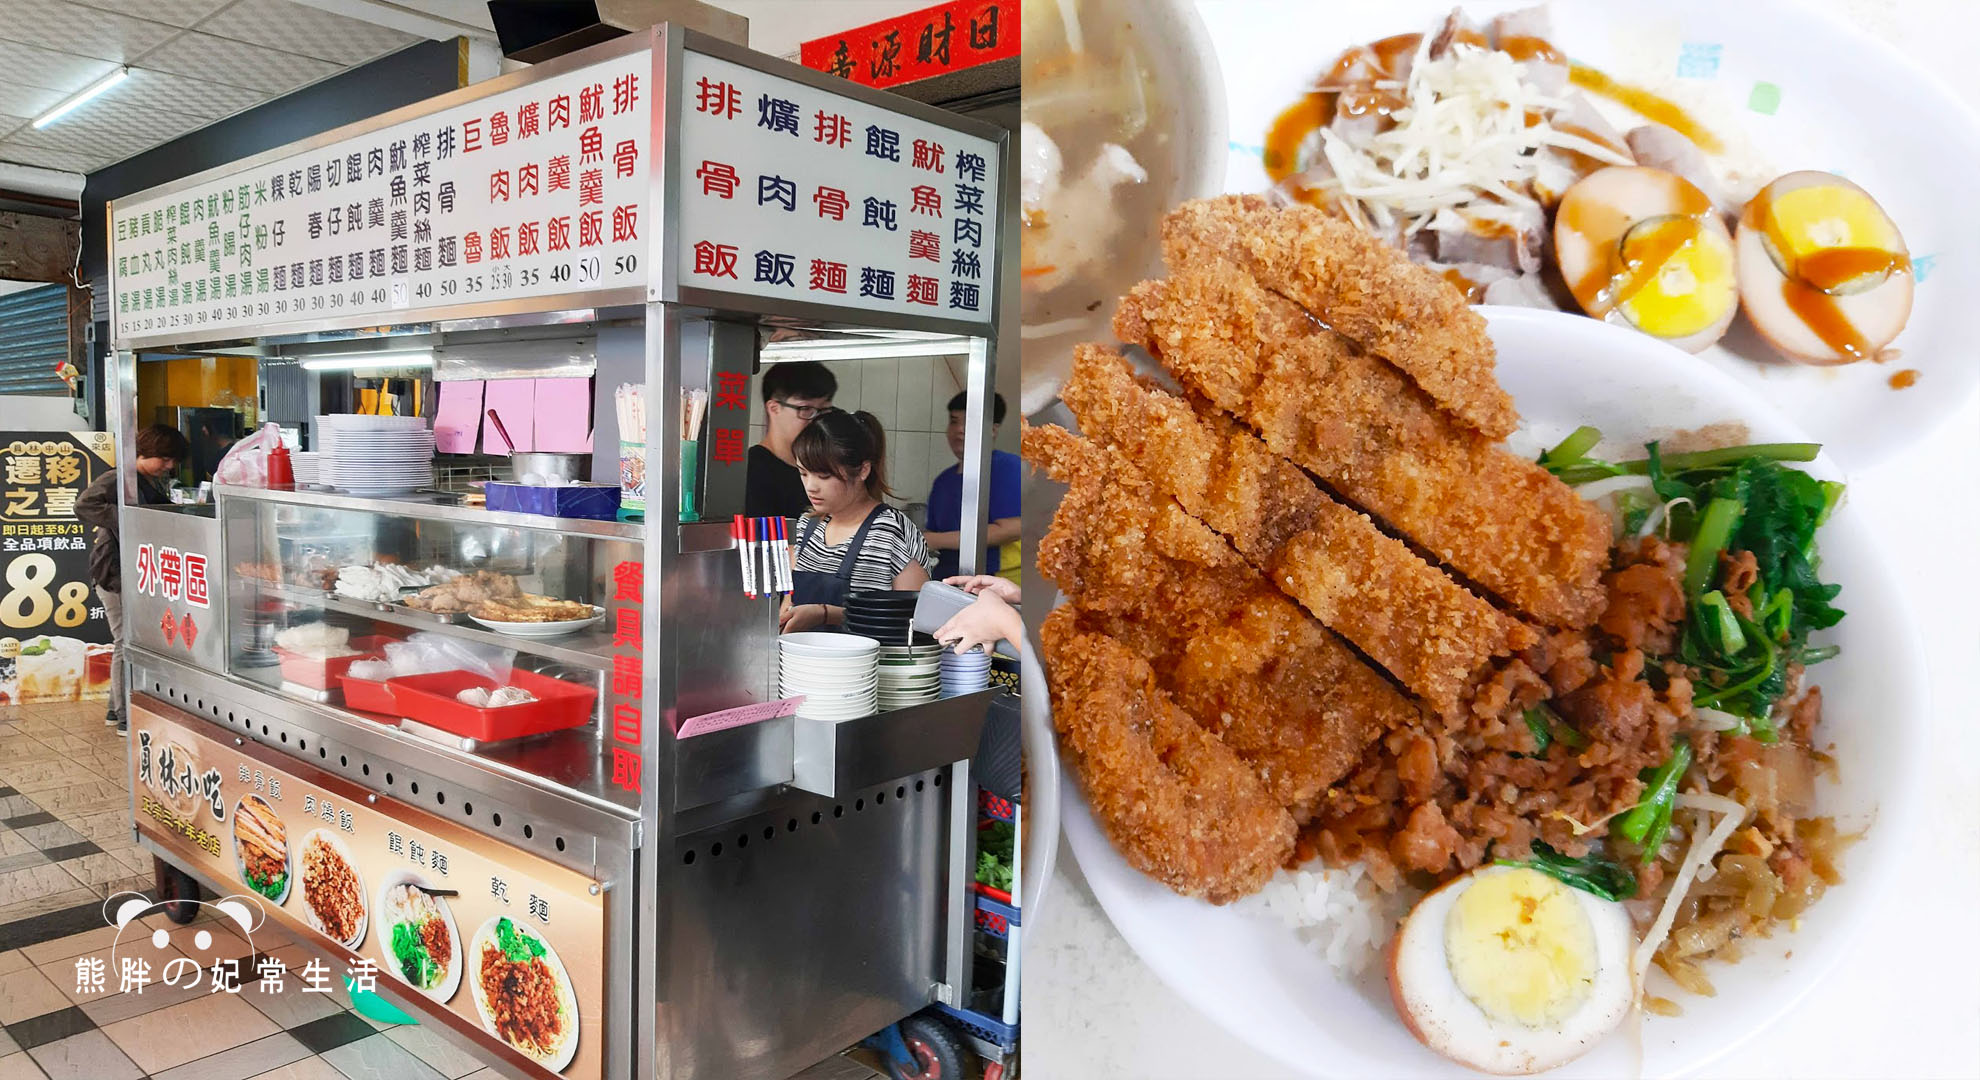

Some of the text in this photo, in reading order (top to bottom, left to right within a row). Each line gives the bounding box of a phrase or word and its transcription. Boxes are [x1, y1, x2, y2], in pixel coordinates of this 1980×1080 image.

[307, 164, 324, 310] 陽春麵 30
[327, 158, 343, 308] 切仔麵 30
[346, 152, 364, 305] 餛飩麵 40
[368, 147, 386, 303] 肉羹麵 40
[389, 139, 408, 305] 魷魚羹麵 50
[412, 132, 432, 299] 榨菜肉絲麵 40
[436, 125, 457, 296] 排骨麵 50
[489, 111, 511, 261] 魯肉飯
[517, 101, 540, 287] 爌肉飯 35
[547, 93, 571, 283] 肉羹飯 40
[578, 83, 604, 283] 魷魚羹飯 50
[612, 72, 639, 275] 排骨飯 50
[693, 76, 743, 281] 排骨飯
[754, 93, 800, 288] 爌肉飯
[809, 110, 852, 295] 排骨麵
[860, 124, 900, 301] 餛飩麵
[906, 138, 945, 307] 魷魚羹麵
[950, 149, 986, 313] 榨菜肉絲麵
[141, 213, 153, 329] 貢丸湯 20
[180, 201, 193, 326] 餛飩湯 30
[194, 198, 207, 324] 肉羹湯 30
[208, 193, 222, 320] 魷魚羹湯 40
[255, 180, 269, 315] 米粉湯 30
[271, 174, 287, 314] 粿仔麵 30
[289, 170, 305, 312] 乾麵 30
[465, 276, 483, 293] 35
[502, 272, 512, 289] 30
[121, 322, 128, 333] 15
[133, 321, 140, 331] 15
[157, 316, 166, 328] 20
[170, 315, 179, 326] 25
[227, 307, 237, 319] 30
[242, 304, 253, 317] 30
[5, 456, 81, 485] 遷移
[12, 442, 72, 454] 員林中山
[714, 371, 750, 467] 菜單
[2, 525, 84, 535] 即日起至8/31
[3, 537, 86, 551] 全品項飲品
[5, 487, 79, 516] 之喜
[137, 545, 209, 607] 外帶區
[611, 560, 644, 794] 餐具請自取
[138, 730, 226, 822] 員林小吃
[141, 796, 221, 858] 正宗三十年老店
[387, 831, 448, 876] 餛飩麵
[490, 876, 550, 922] 乾麵
